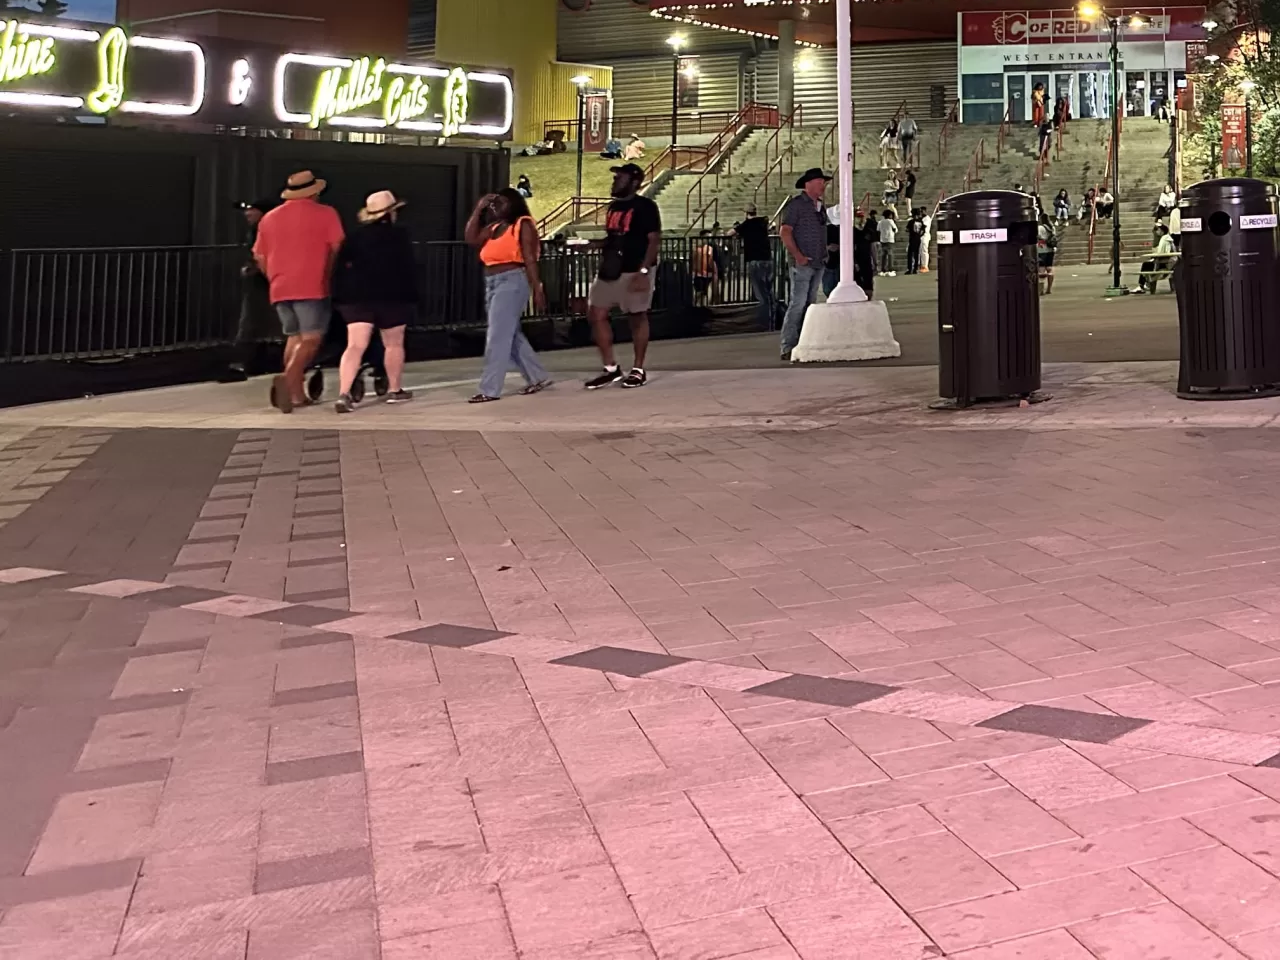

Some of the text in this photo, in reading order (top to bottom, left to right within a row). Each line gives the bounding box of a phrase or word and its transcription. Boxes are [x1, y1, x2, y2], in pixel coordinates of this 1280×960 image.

[1029, 23, 1049, 33] OF
[1053, 20, 1091, 34] RED
[1003, 51, 1124, 62] WEST ENTRANE
[229, 58, 251, 106] &
[310, 56, 430, 129] Mullet Cuts
[1249, 217, 1274, 226] RECYCLE
[970, 232, 997, 240] TRASH
